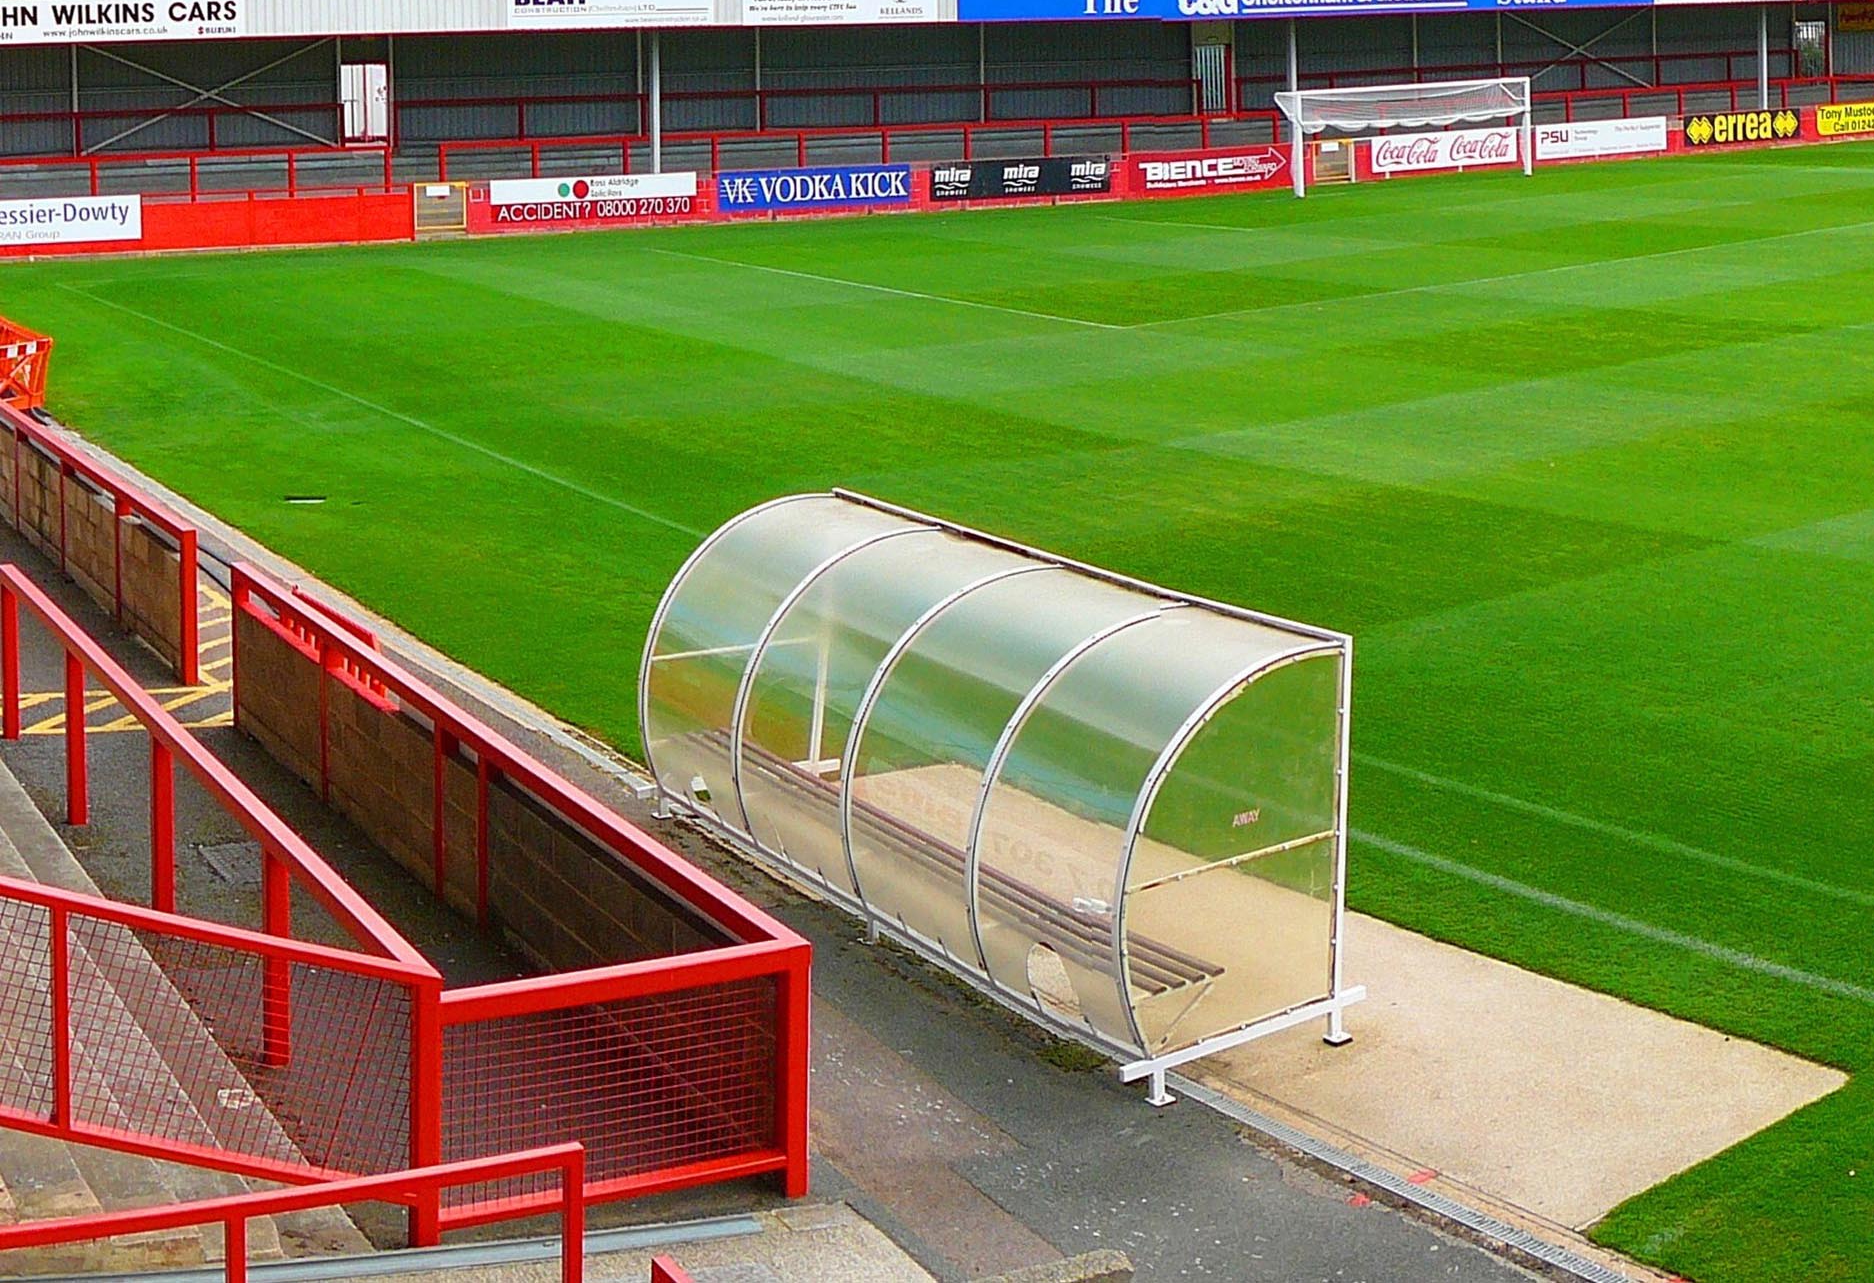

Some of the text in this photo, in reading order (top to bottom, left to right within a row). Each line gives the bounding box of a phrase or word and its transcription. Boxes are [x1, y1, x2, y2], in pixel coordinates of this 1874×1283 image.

[52, 1, 237, 25] WILKINS CARS
[514, 6, 587, 14] CONSTRUCTION
[43, 27, 168, 38] www.johnwilkinscars.co.uk
[1820, 108, 1842, 121] Tony
[1833, 119, 1874, 132] Call 01242
[1541, 130, 1569, 144] PSU
[1376, 136, 1441, 167] Coca-Cola
[1450, 132, 1511, 161] Coca-Cola
[934, 167, 971, 182] mira
[1003, 164, 1039, 179] mira
[1071, 161, 1106, 176] mira
[722, 171, 908, 204] VK VODKA KICK
[0, 203, 129, 226] essier-Dowty
[498, 197, 690, 221] ACCIDENT? 08000 270 370
[26, 230, 60, 240] Group
